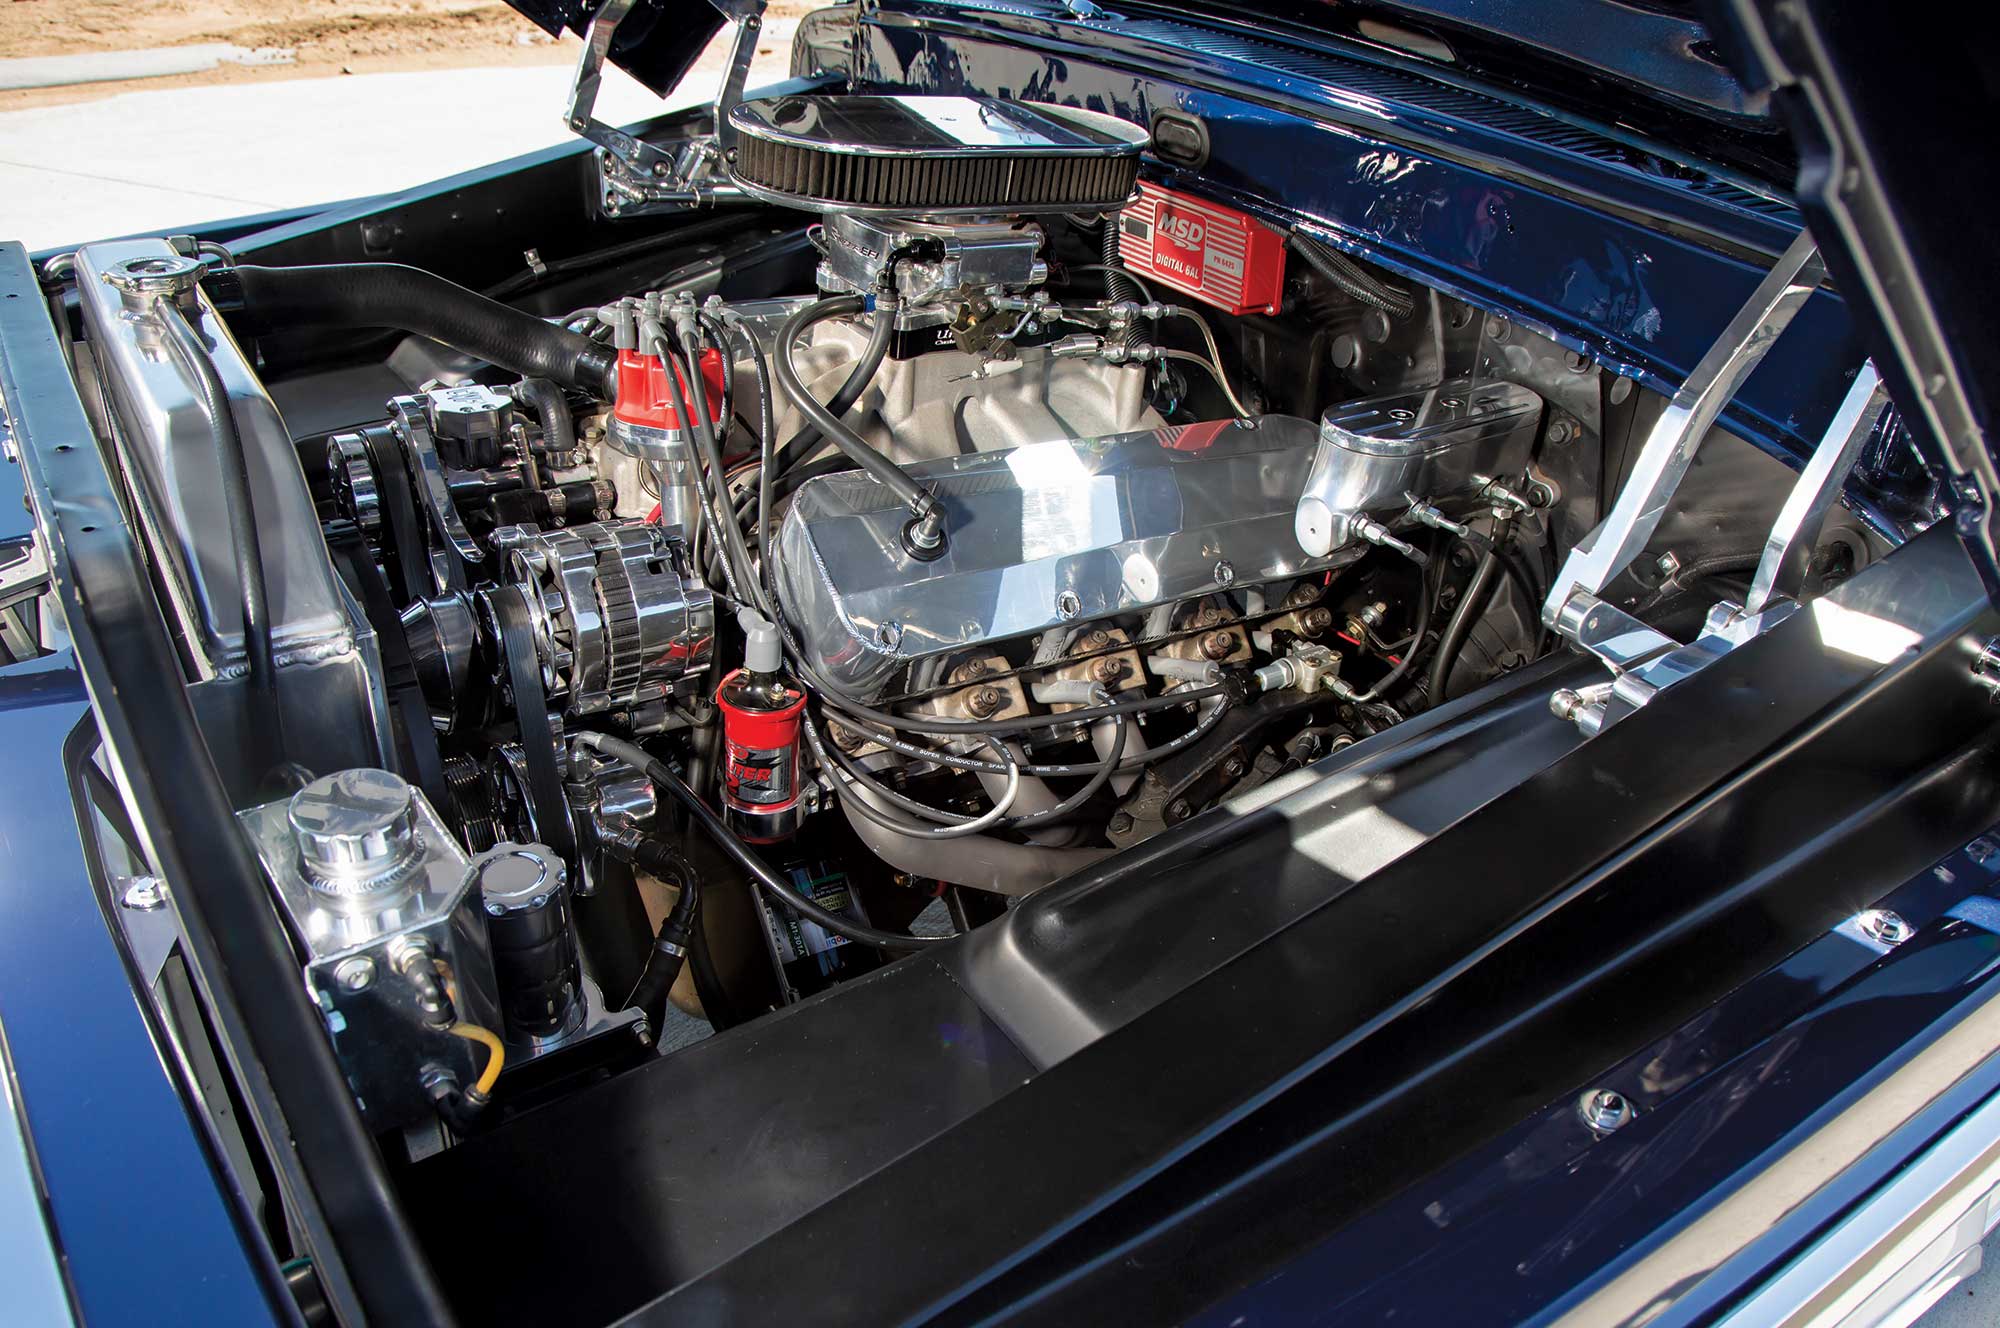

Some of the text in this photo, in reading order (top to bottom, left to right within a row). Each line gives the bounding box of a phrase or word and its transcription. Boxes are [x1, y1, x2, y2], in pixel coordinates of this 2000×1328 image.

[1158, 213, 1204, 243] MSD
[1156, 253, 1200, 280] DIGITAL 6AL
[718, 550, 737, 587] CONDUCTOR
[919, 748, 940, 759] SUPER
[945, 755, 983, 767] CONDUCTOR
